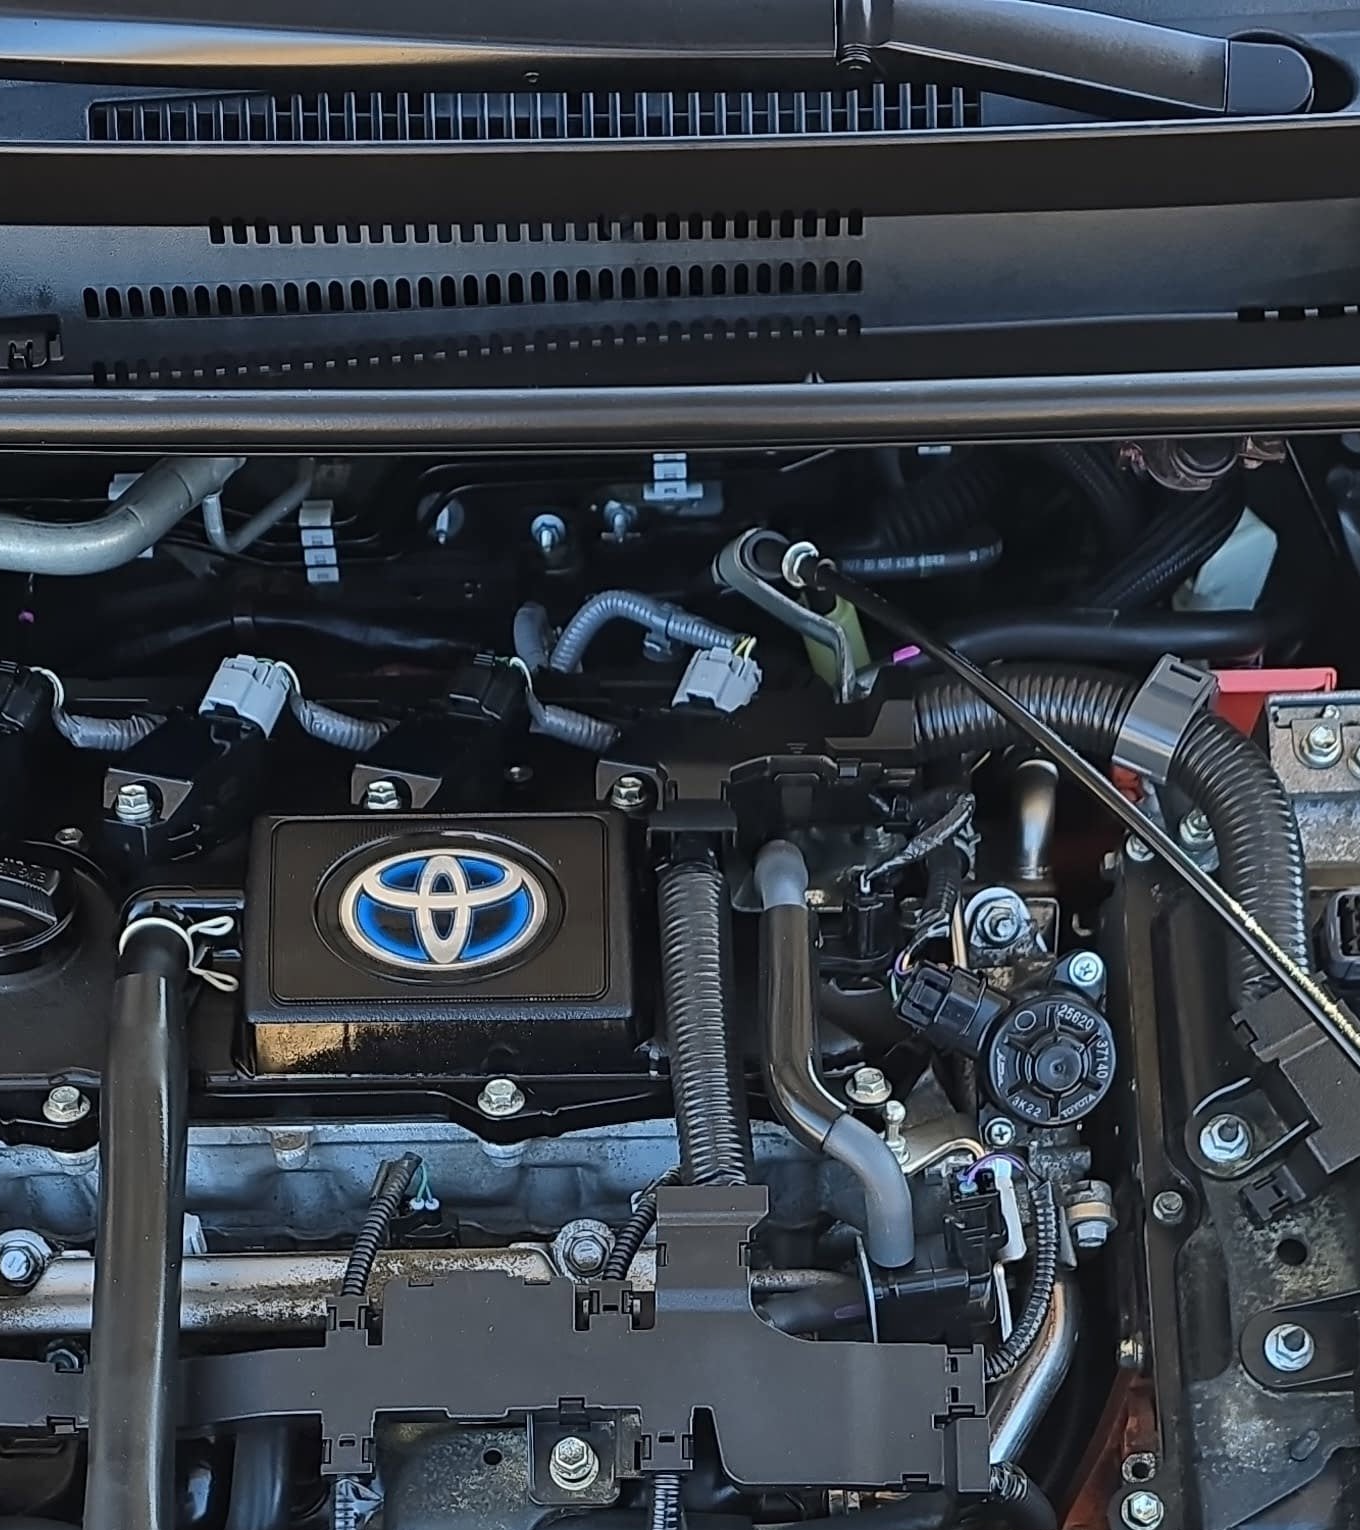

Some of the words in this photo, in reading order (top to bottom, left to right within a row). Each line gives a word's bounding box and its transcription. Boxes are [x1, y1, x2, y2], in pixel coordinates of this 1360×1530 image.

[1057, 1004, 1095, 1031] 25620
[1096, 1040, 1110, 1079] 37140
[1011, 1095, 1042, 1118] 3K22
[1060, 1093, 1097, 1118] TOYOTA
